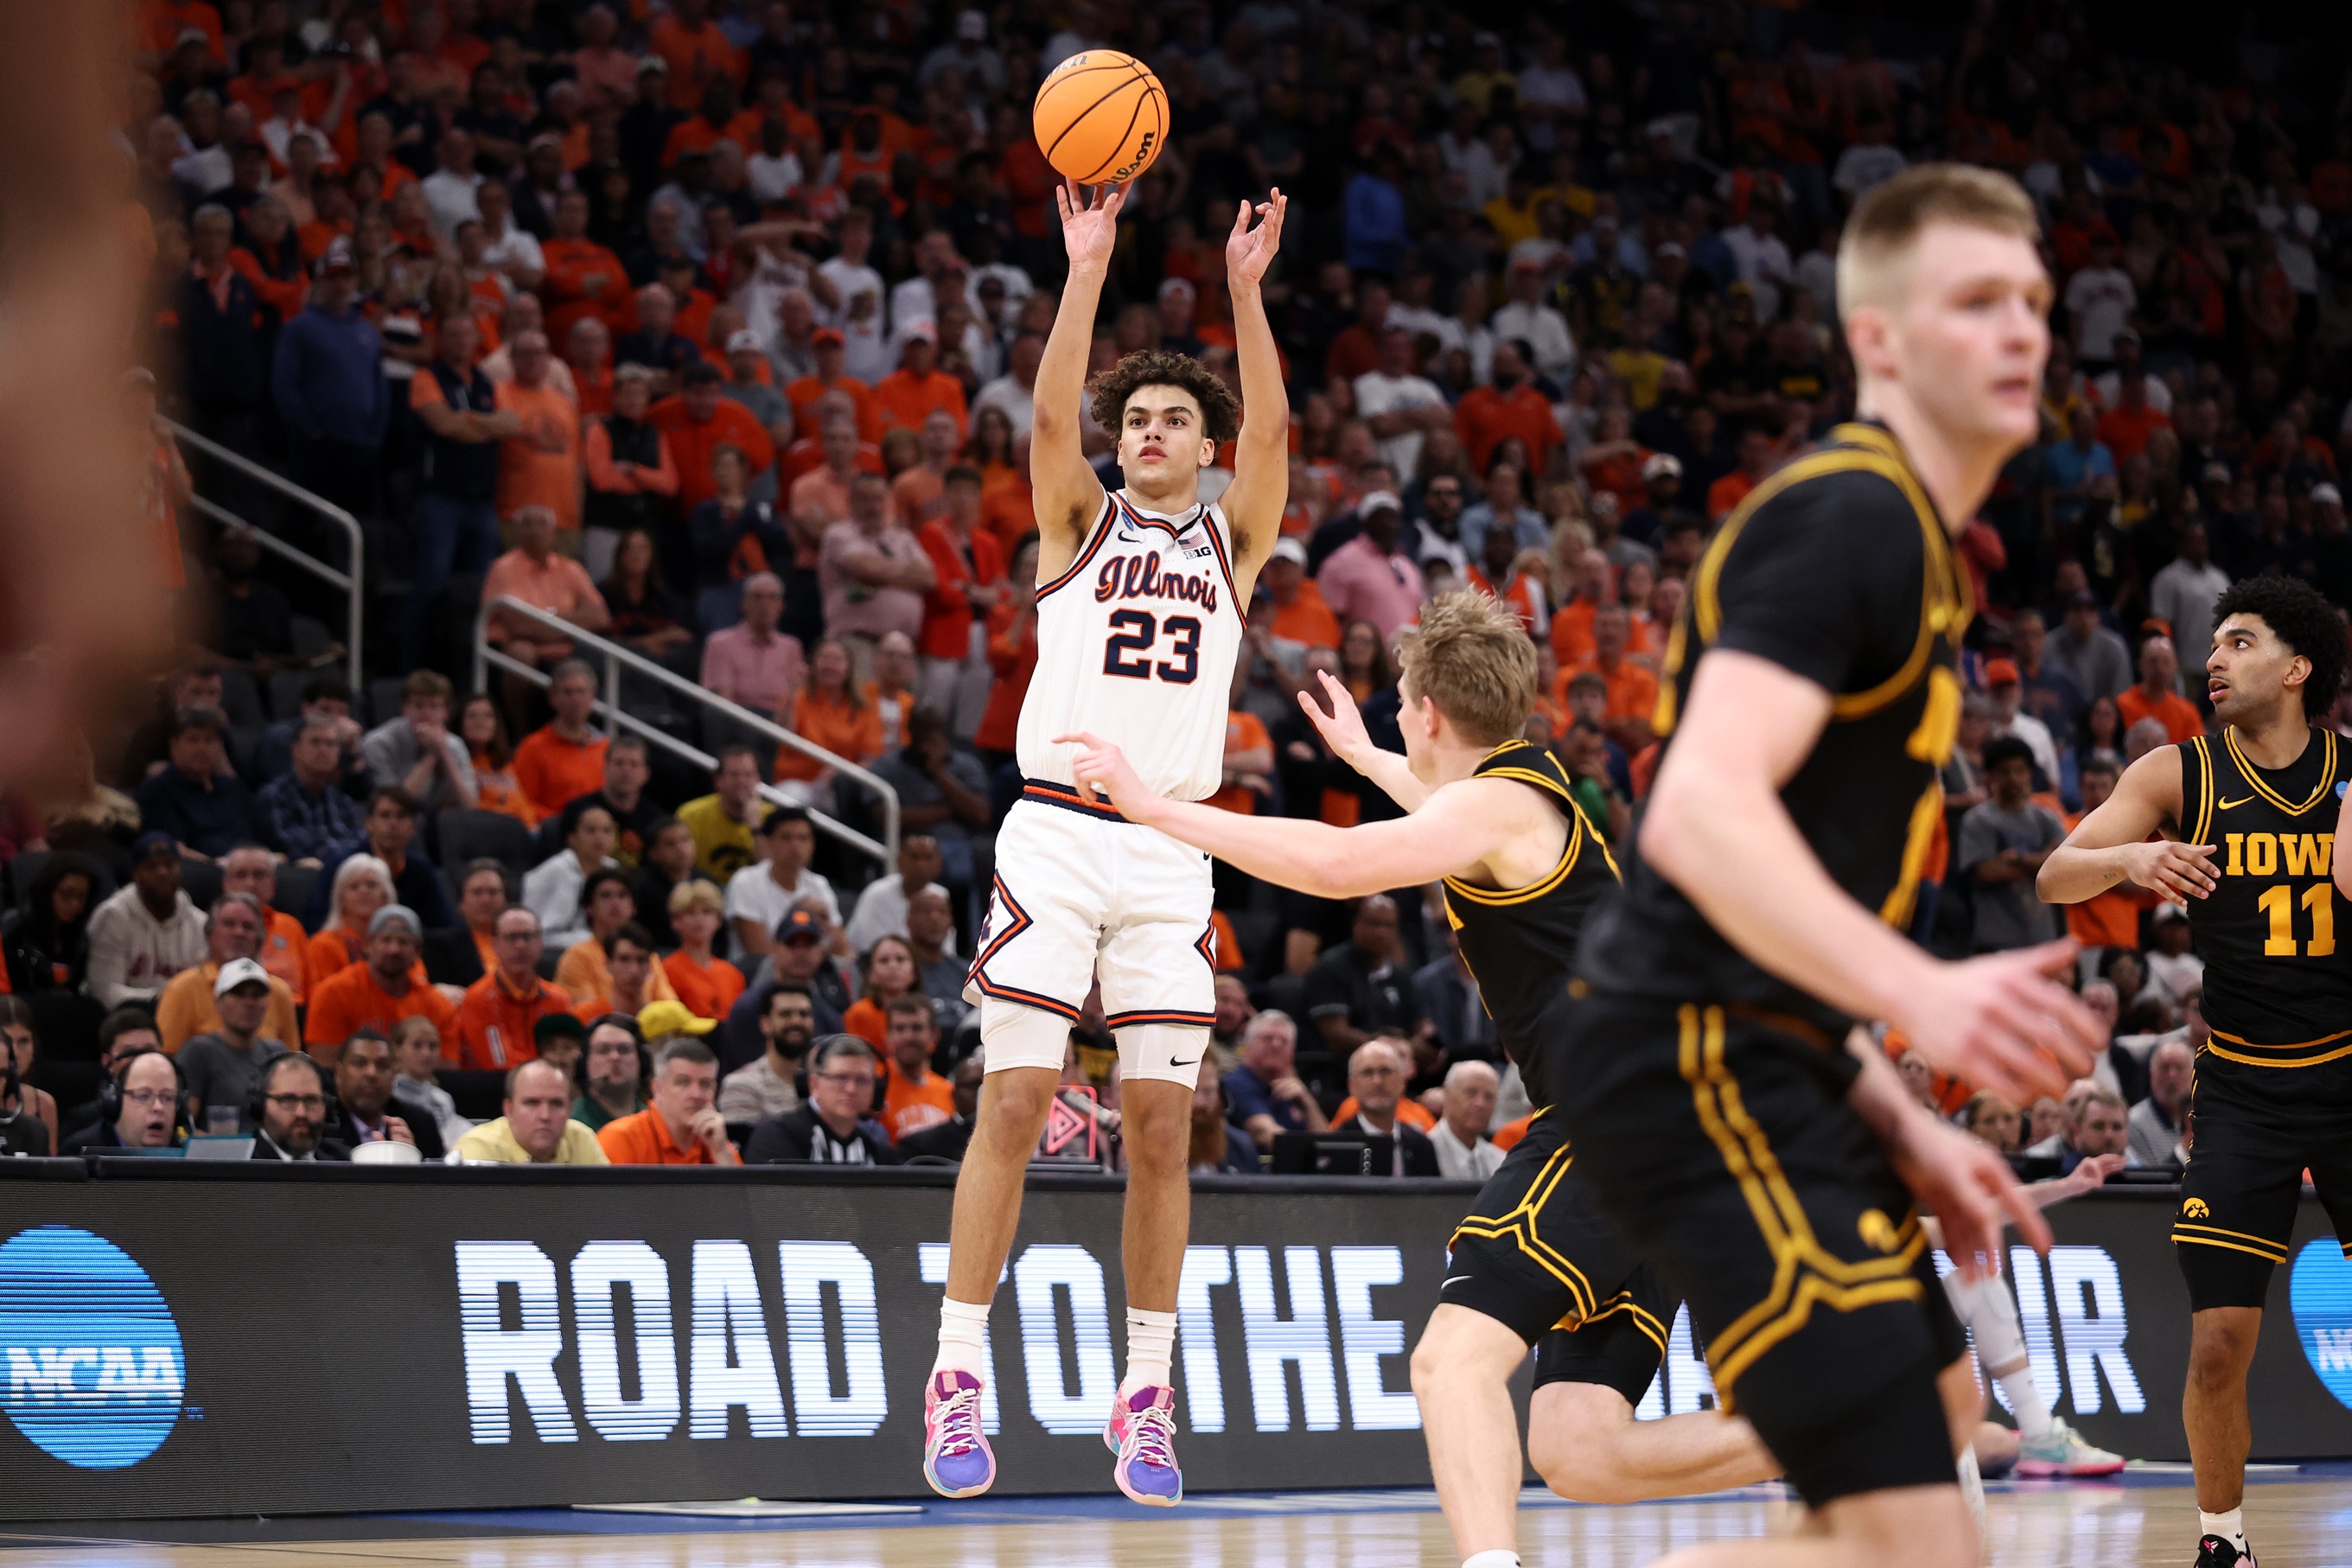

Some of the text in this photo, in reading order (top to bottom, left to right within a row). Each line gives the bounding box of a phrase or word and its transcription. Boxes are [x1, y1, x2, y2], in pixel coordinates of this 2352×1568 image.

[1103, 607, 1202, 685] 23
[2225, 832, 2334, 876] IOW
[2258, 883, 2336, 957] 11
[7, 1347, 183, 1405] NCAA
[455, 1240, 889, 1444] ROAD
[1176, 1245, 1423, 1433] THE
